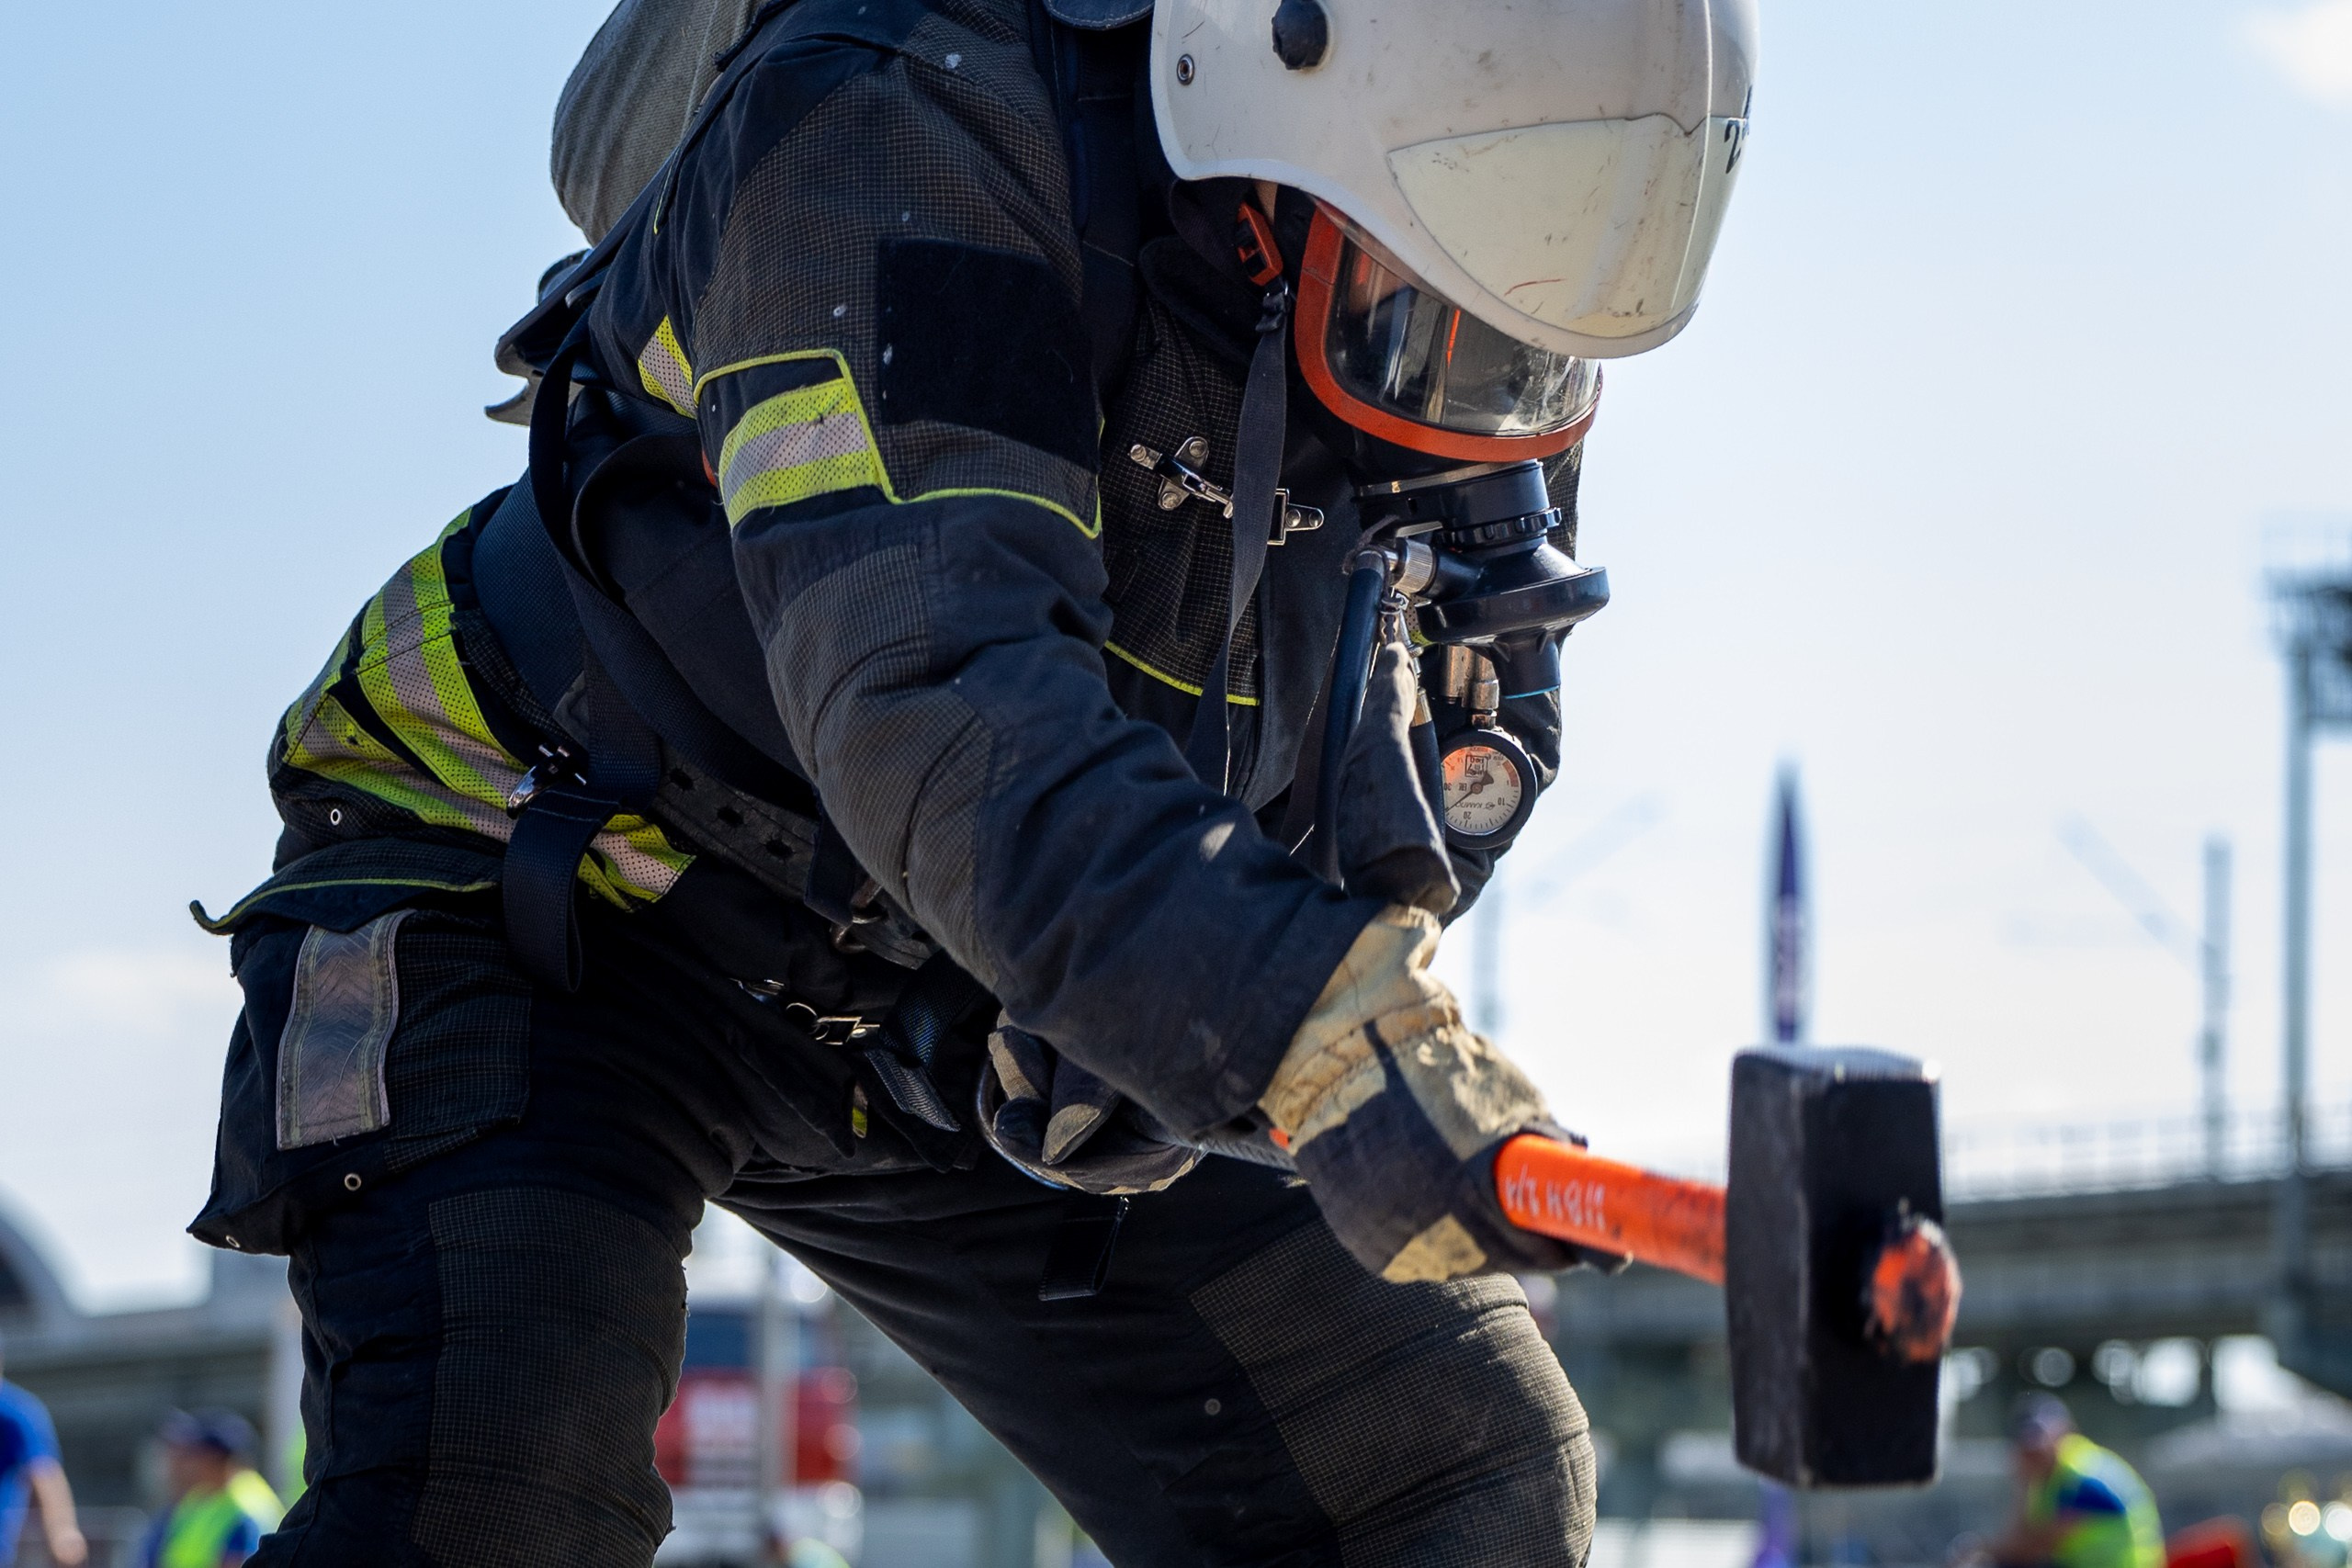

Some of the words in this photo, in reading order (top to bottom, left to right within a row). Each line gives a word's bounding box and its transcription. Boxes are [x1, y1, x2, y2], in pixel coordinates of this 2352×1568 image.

[1443, 783, 1452, 791] 30
[1498, 797, 1505, 806] 10
[1464, 811, 1472, 819] 20
